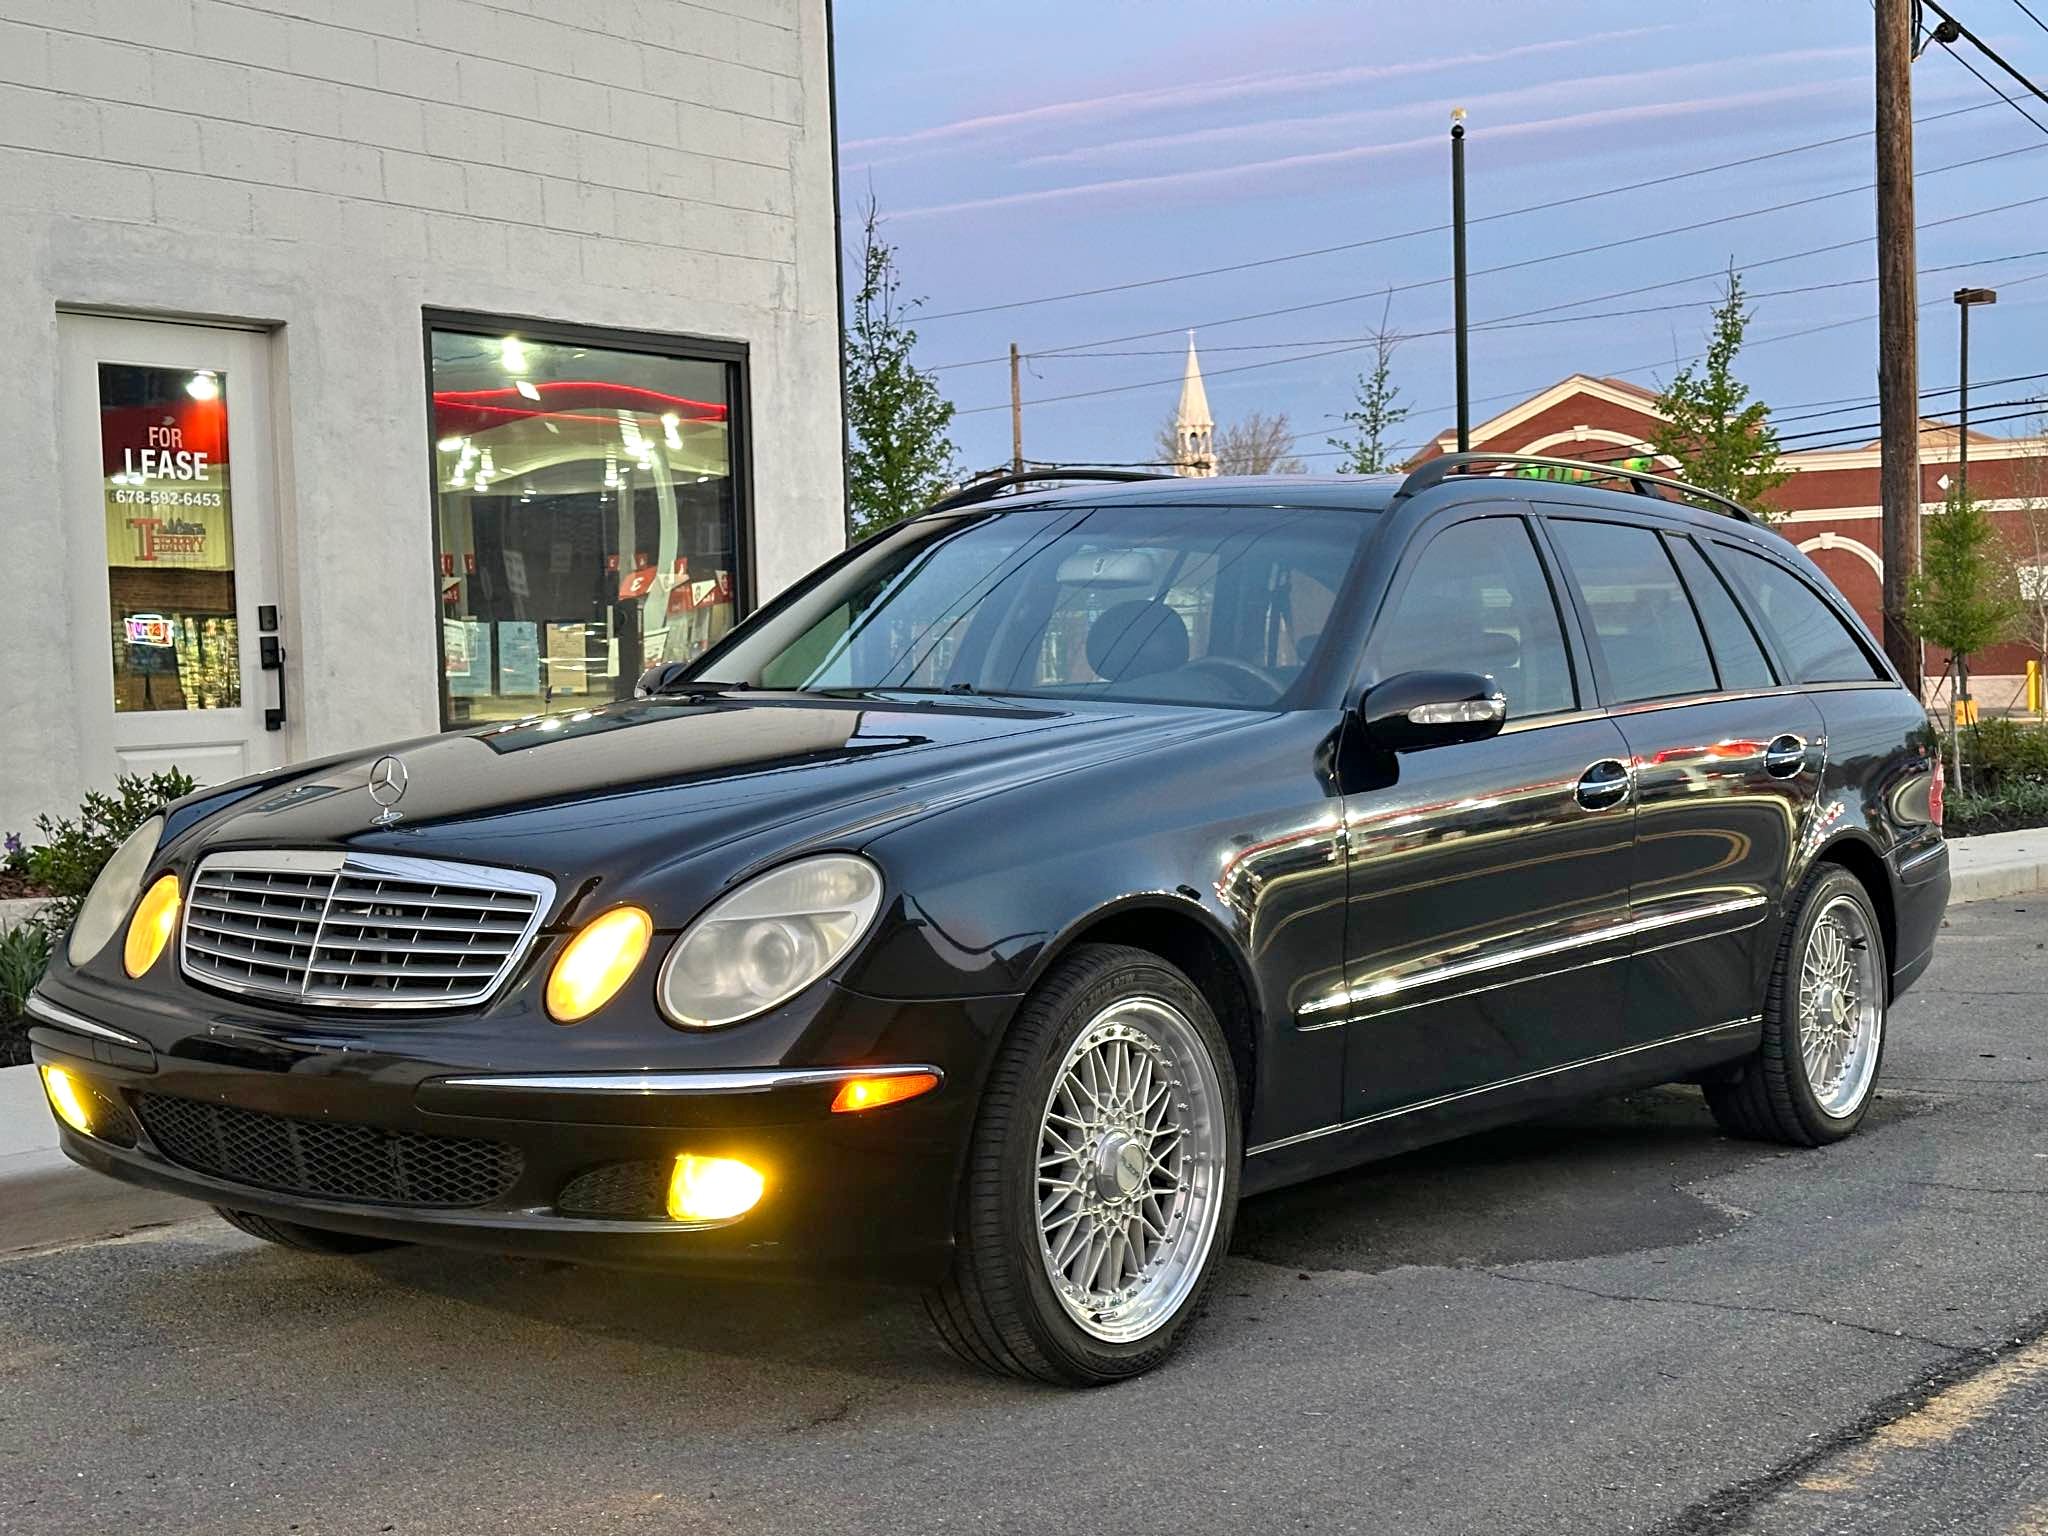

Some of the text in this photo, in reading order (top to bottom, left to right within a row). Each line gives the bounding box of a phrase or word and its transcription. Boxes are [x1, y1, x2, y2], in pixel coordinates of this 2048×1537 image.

[148, 426, 183, 449] FOR
[124, 448, 209, 481] LEASE
[116, 489, 221, 507] 678-592-6453
